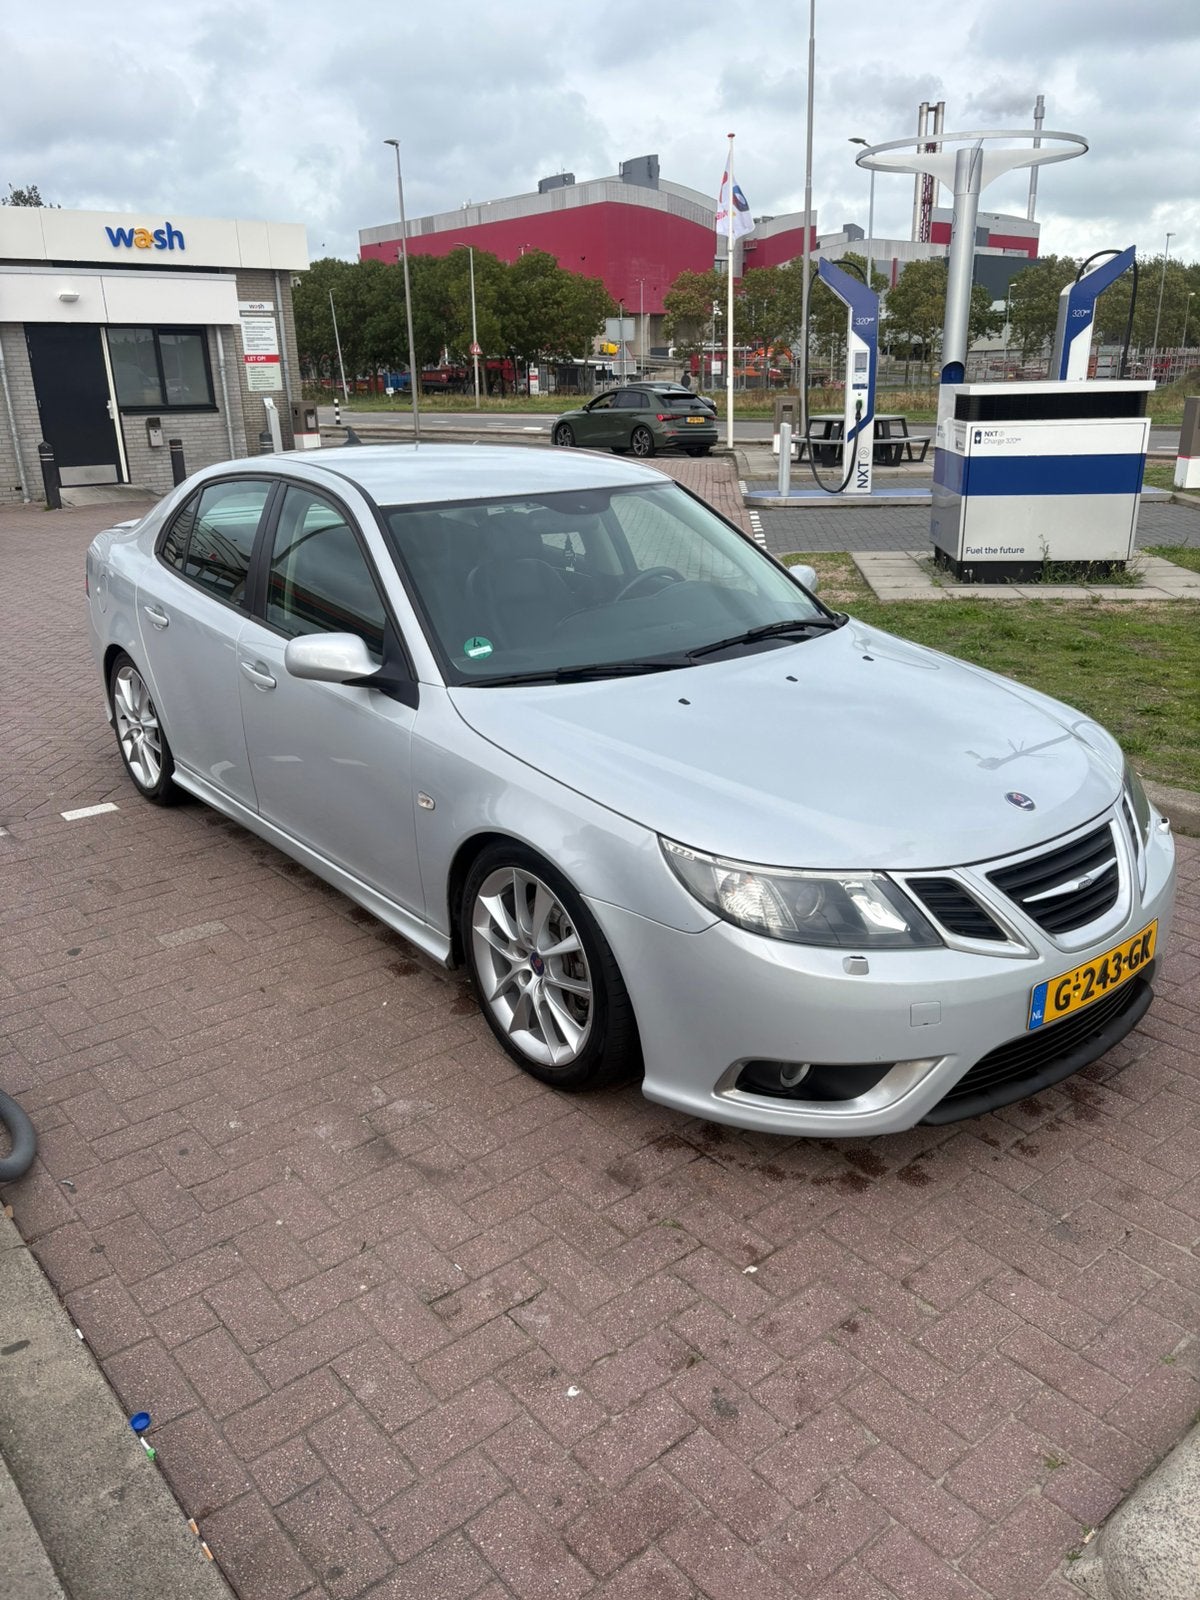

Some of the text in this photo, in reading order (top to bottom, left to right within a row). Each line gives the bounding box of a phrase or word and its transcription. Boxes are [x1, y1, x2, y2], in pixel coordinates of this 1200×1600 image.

[104, 222, 185, 250] wash
[857, 461, 869, 488] NXT
[965, 546, 1025, 554] Fuel the future
[1054, 930, 1152, 1011] G-243-GK
[1032, 1009, 1043, 1021] NL
